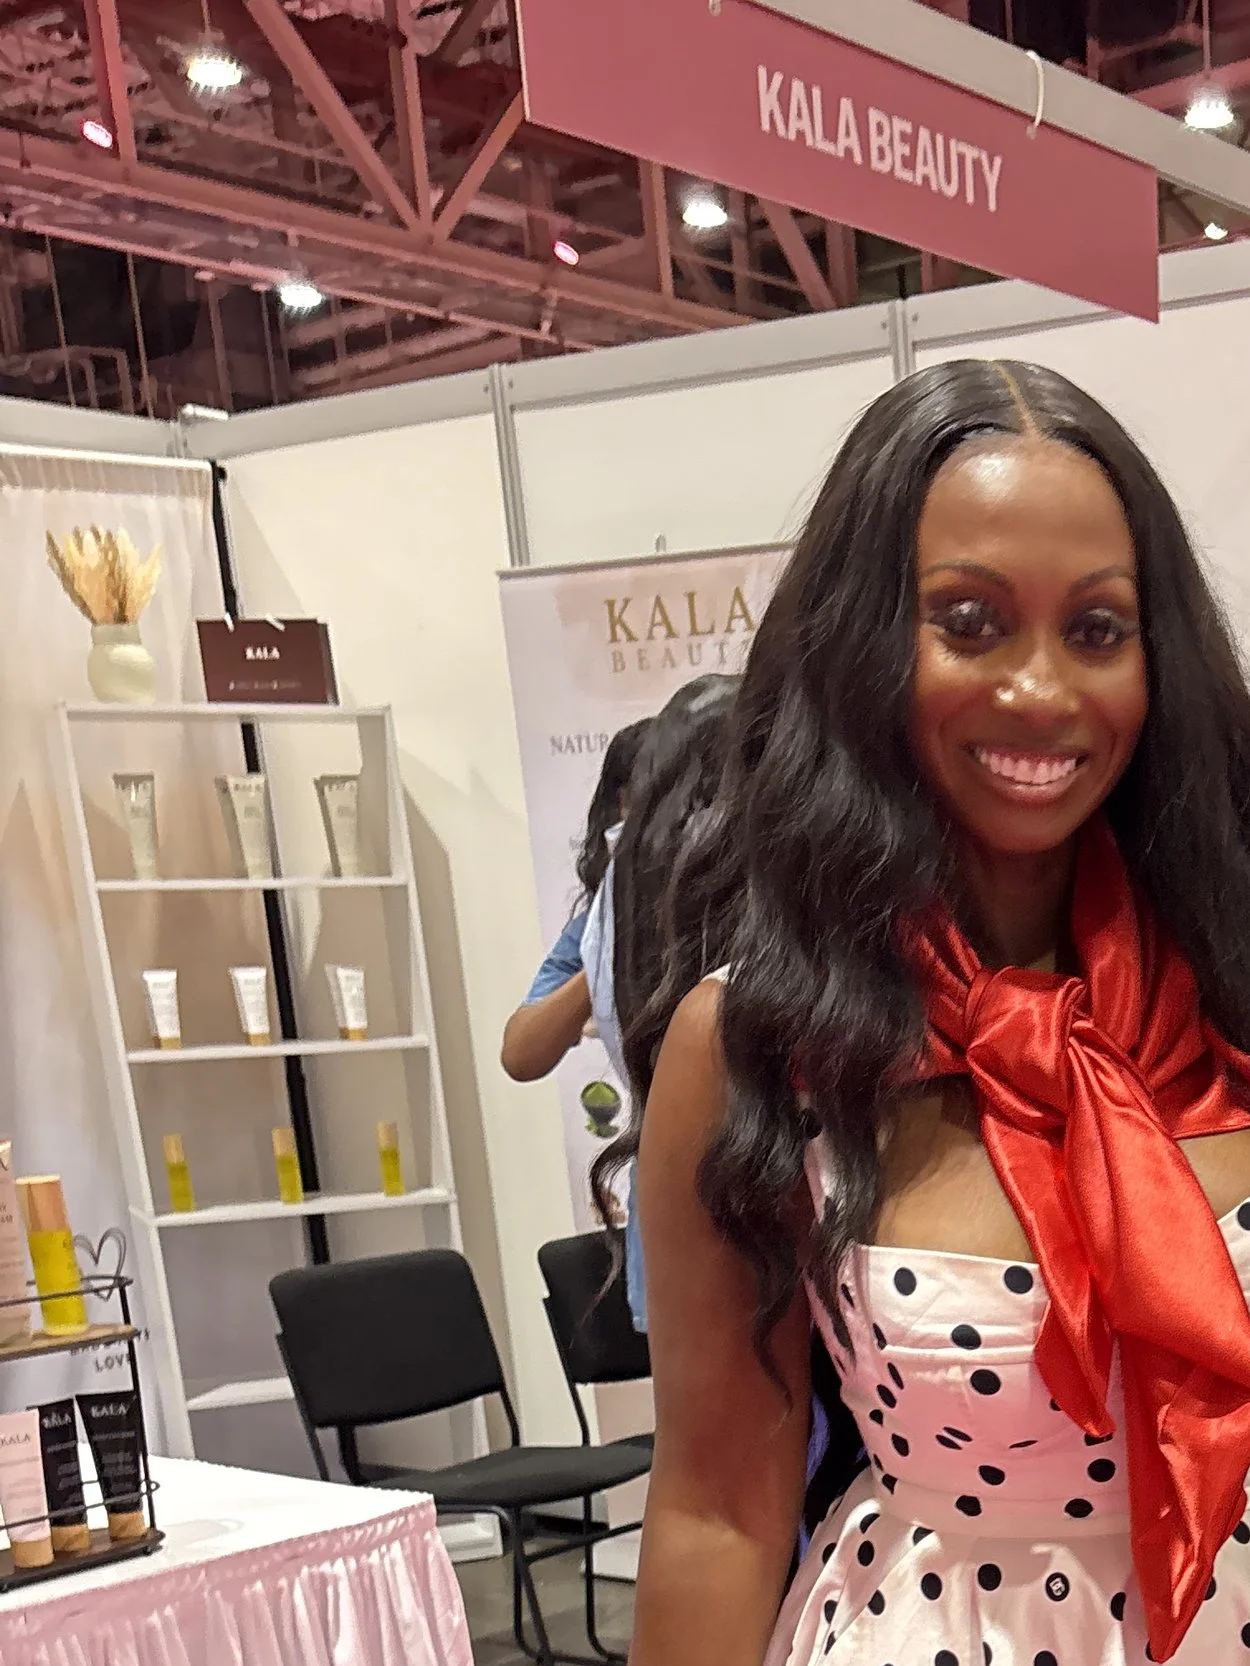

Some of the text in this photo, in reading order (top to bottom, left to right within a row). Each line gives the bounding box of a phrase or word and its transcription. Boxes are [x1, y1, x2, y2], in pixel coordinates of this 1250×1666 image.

[757, 64, 1003, 214] KALA BEAUTY
[604, 585, 755, 644] KALA
[612, 638, 750, 673] BEAUT
